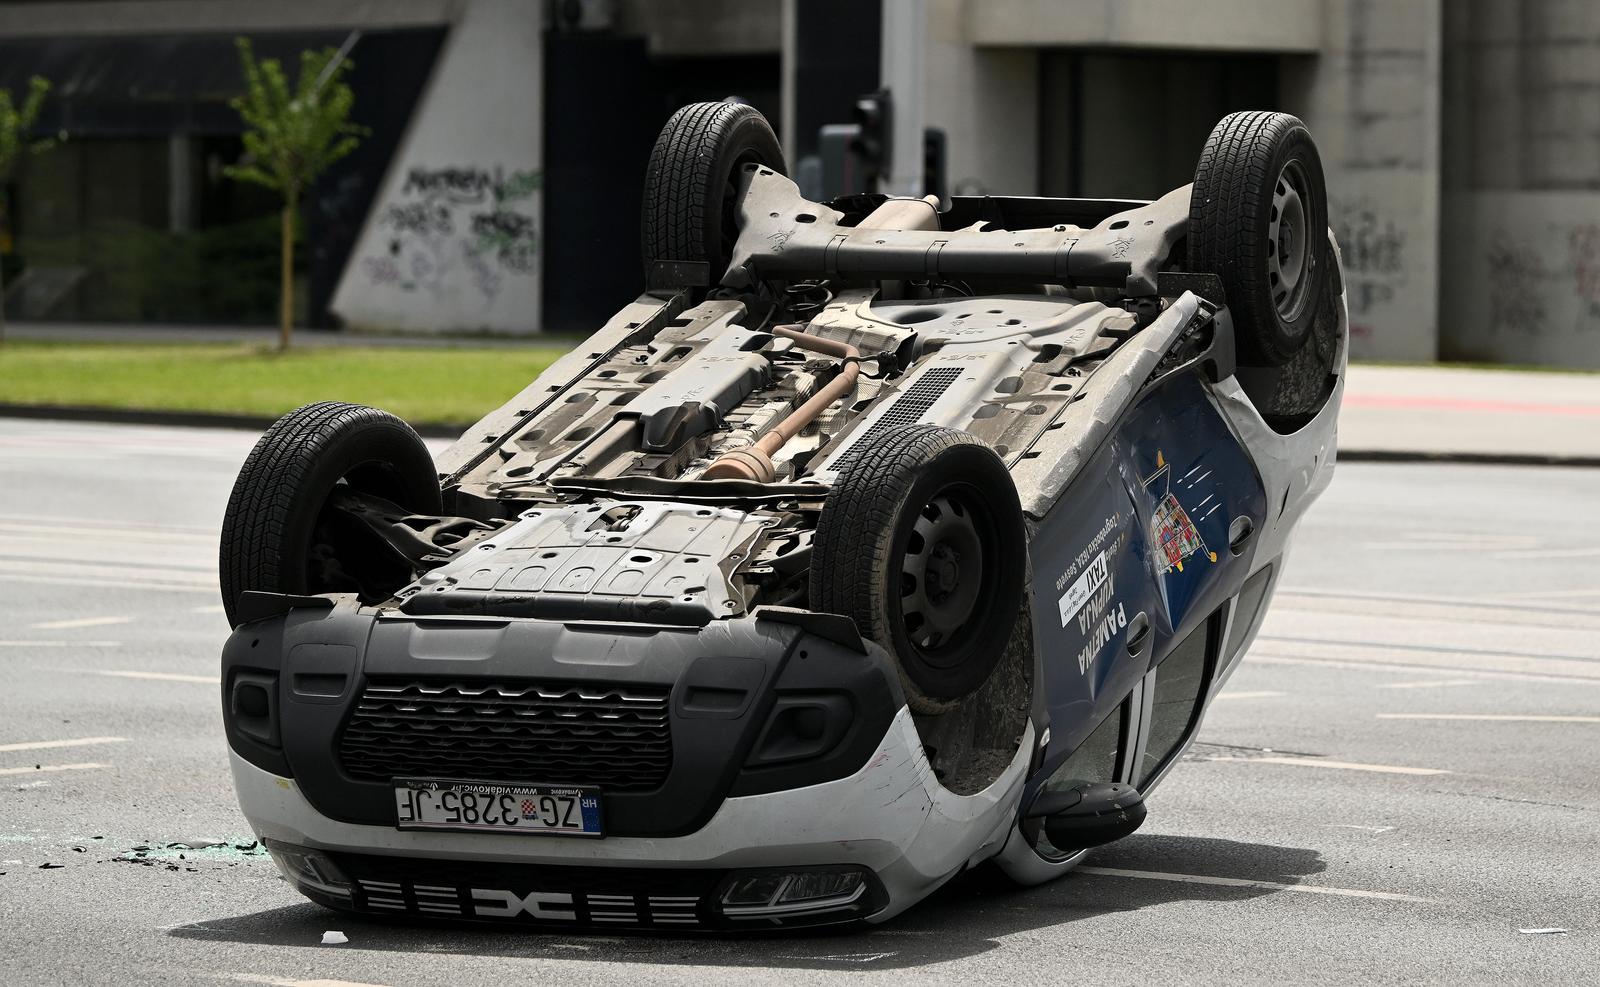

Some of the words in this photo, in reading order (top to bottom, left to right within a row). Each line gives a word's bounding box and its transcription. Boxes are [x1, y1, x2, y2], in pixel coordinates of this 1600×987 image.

[1086, 557, 1105, 593] TAXI
[1078, 572, 1114, 636] KUPNJA
[1078, 602, 1127, 675] PAMETNA
[451, 784, 538, 796] www.vidakovic.hr
[582, 799, 597, 808] HR
[540, 796, 579, 828] ZG
